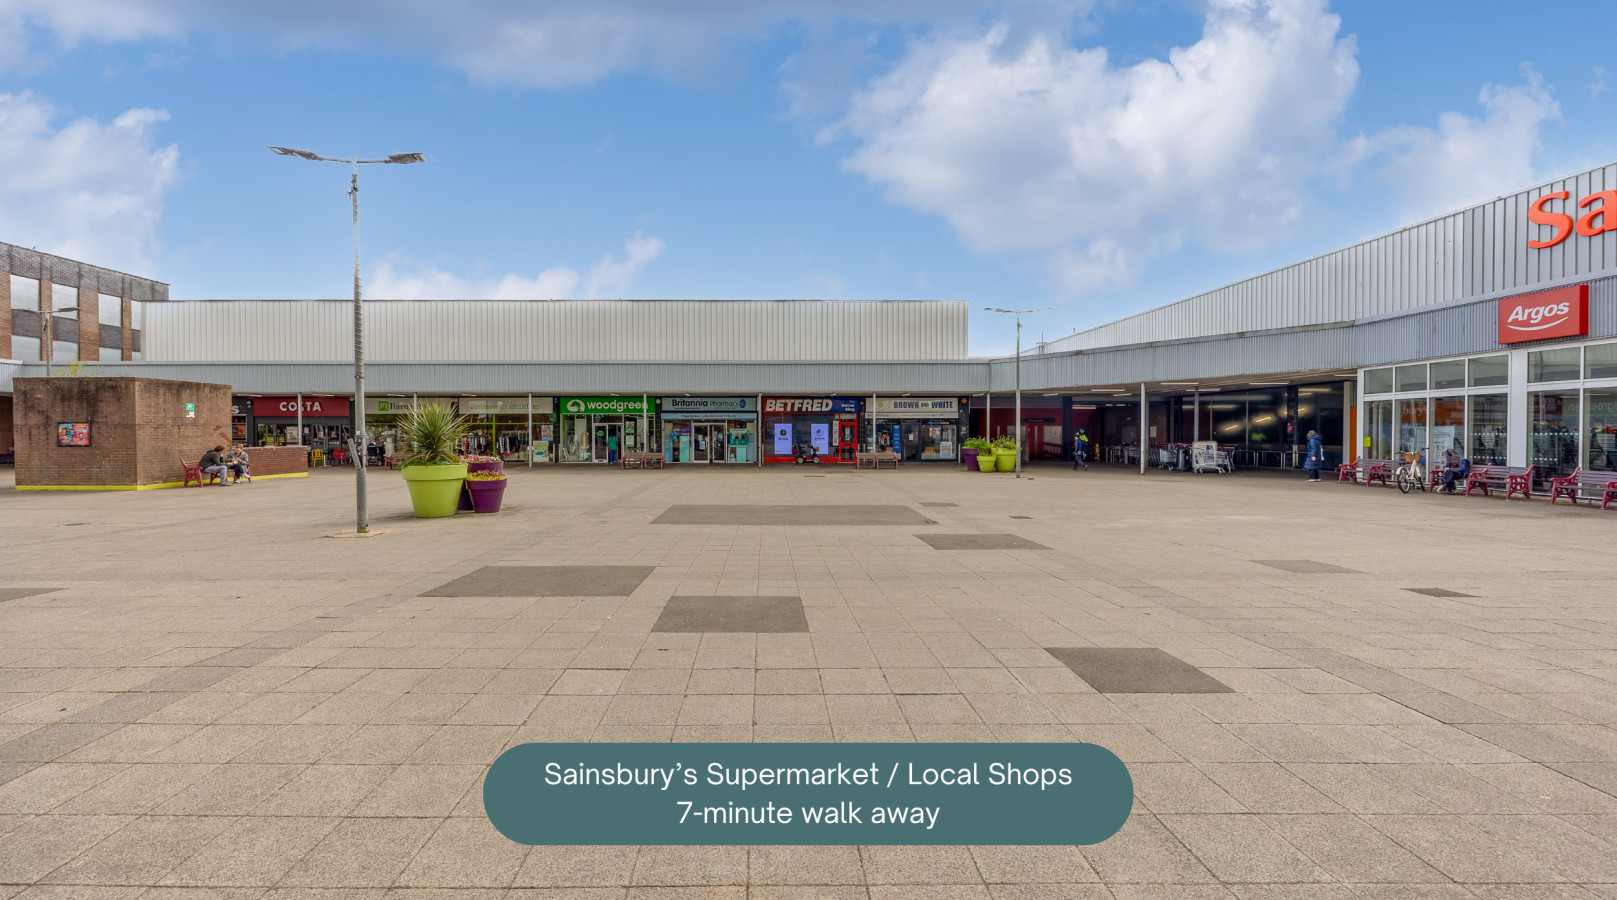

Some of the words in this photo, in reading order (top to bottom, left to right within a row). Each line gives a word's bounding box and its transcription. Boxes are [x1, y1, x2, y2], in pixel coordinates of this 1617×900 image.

[1507, 302, 1570, 324] Argos
[510, 402, 543, 410] childen
[672, 399, 708, 407] Britannia
[710, 400, 739, 408] Pharmacy
[765, 398, 833, 412] BETFRED
[893, 401, 919, 409] BROWN
[931, 401, 953, 409] WHITE
